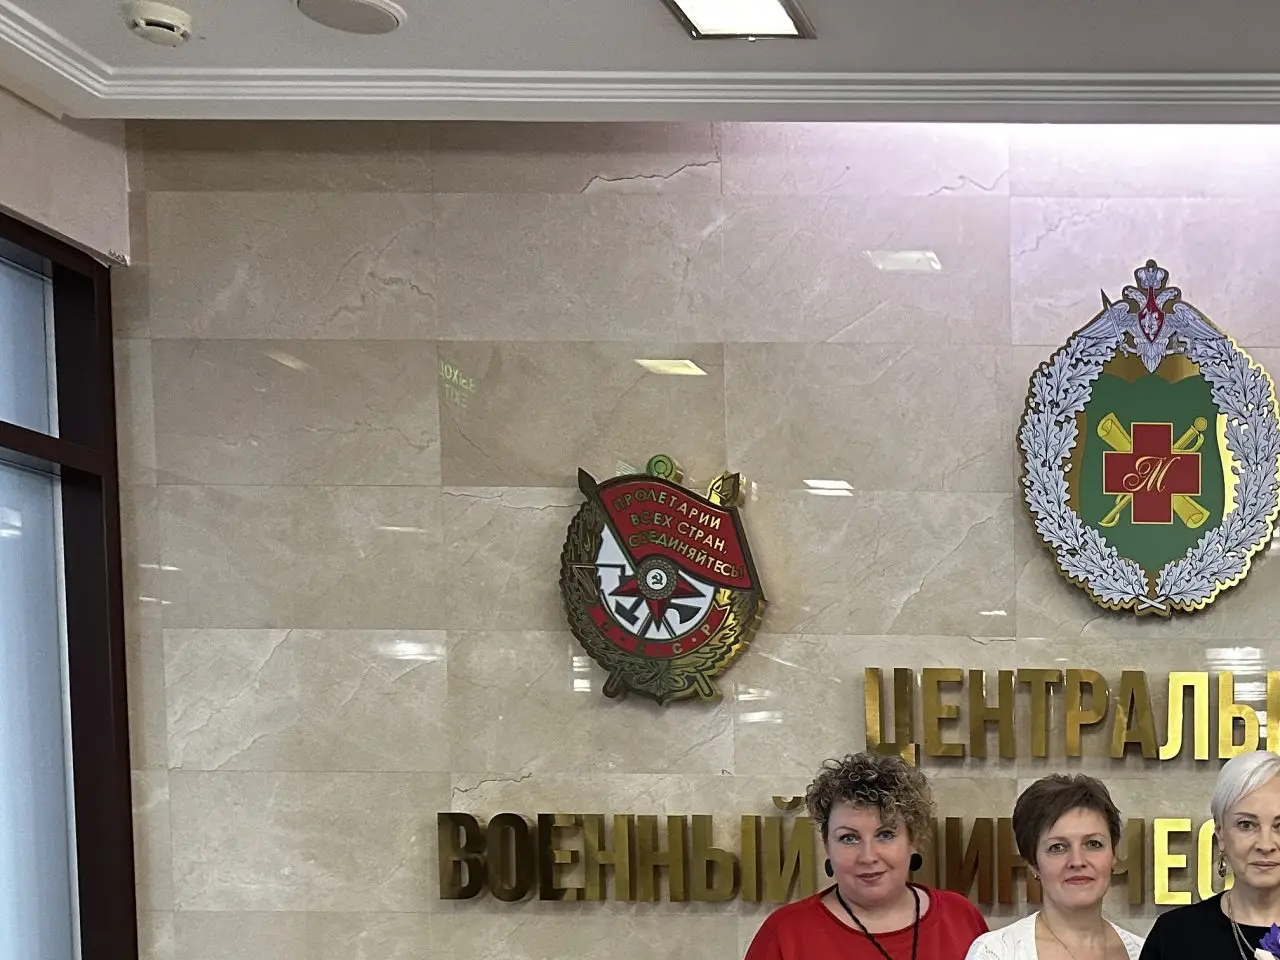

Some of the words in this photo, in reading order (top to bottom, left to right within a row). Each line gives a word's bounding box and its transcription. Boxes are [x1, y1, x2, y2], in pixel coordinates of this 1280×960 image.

[613, 488, 721, 531] ПРОЛЕТАРИИ
[630, 512, 673, 528] ВСЕХ
[677, 522, 727, 554] СТРАН,
[437, 795, 817, 903] ВОЕННЫЙ
